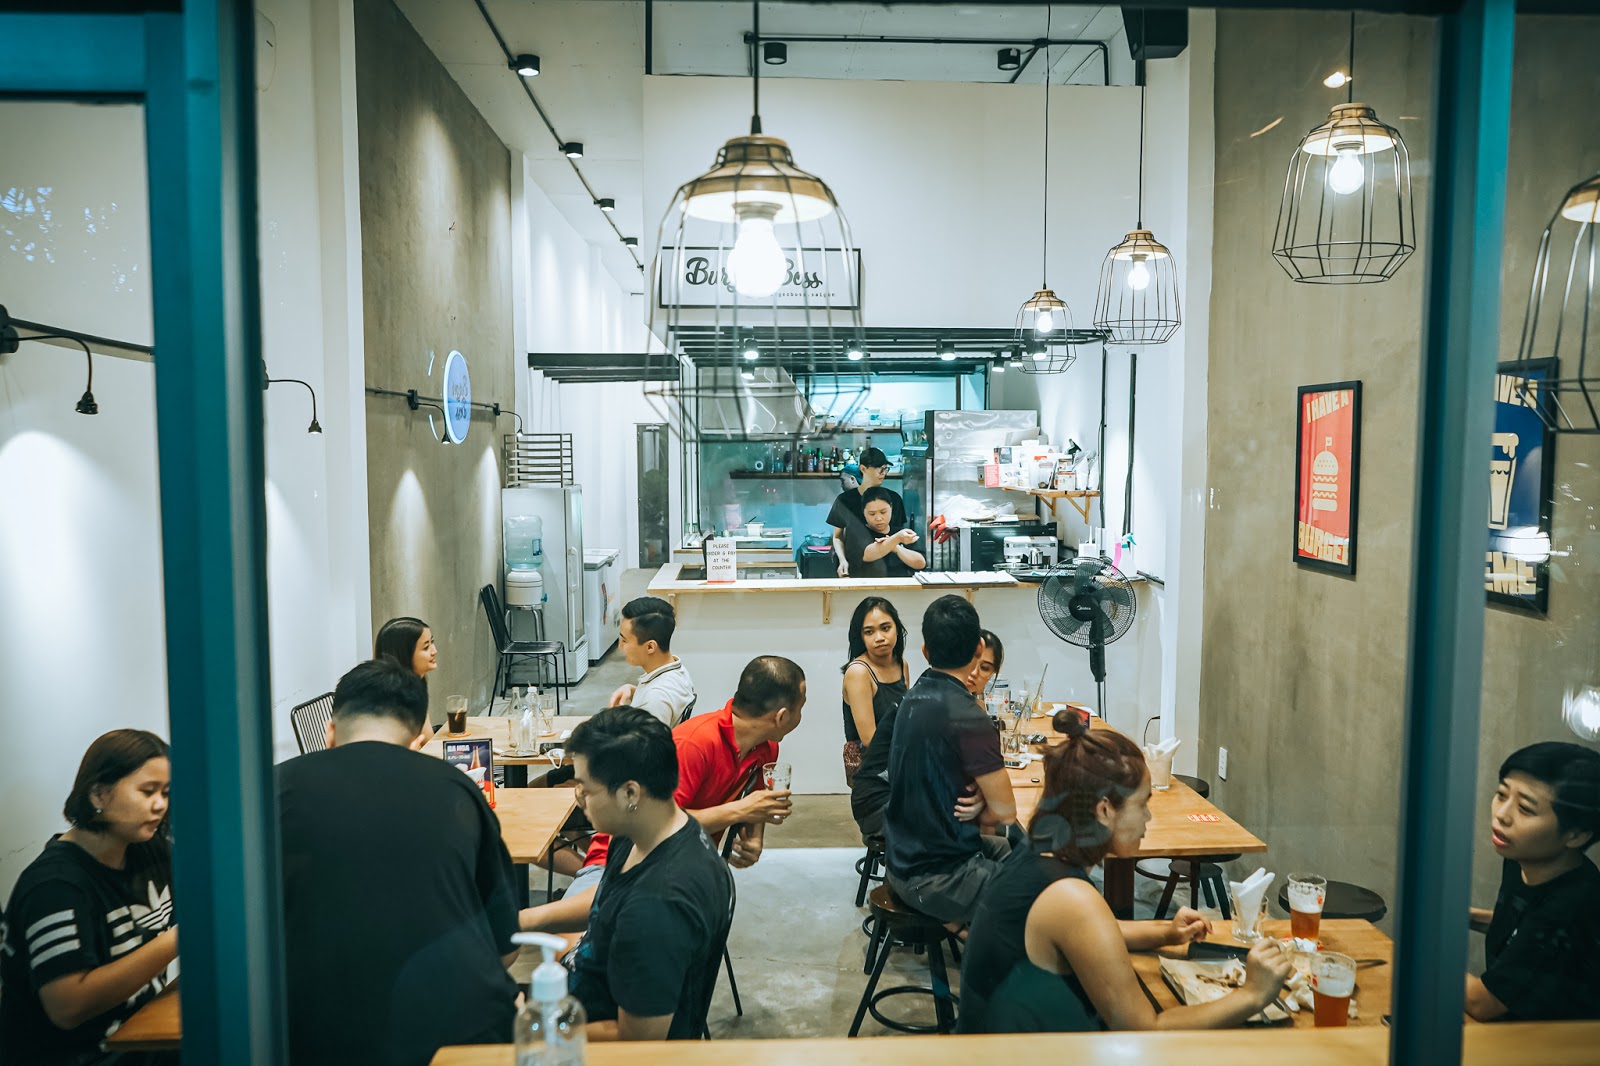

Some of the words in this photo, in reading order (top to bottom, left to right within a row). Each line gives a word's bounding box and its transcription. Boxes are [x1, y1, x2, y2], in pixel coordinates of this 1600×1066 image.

[685, 256, 737, 293] Bur
[1311, 390, 1340, 422] HAVE
[1340, 389, 1349, 408] A
[1298, 520, 1349, 566] BURGER
